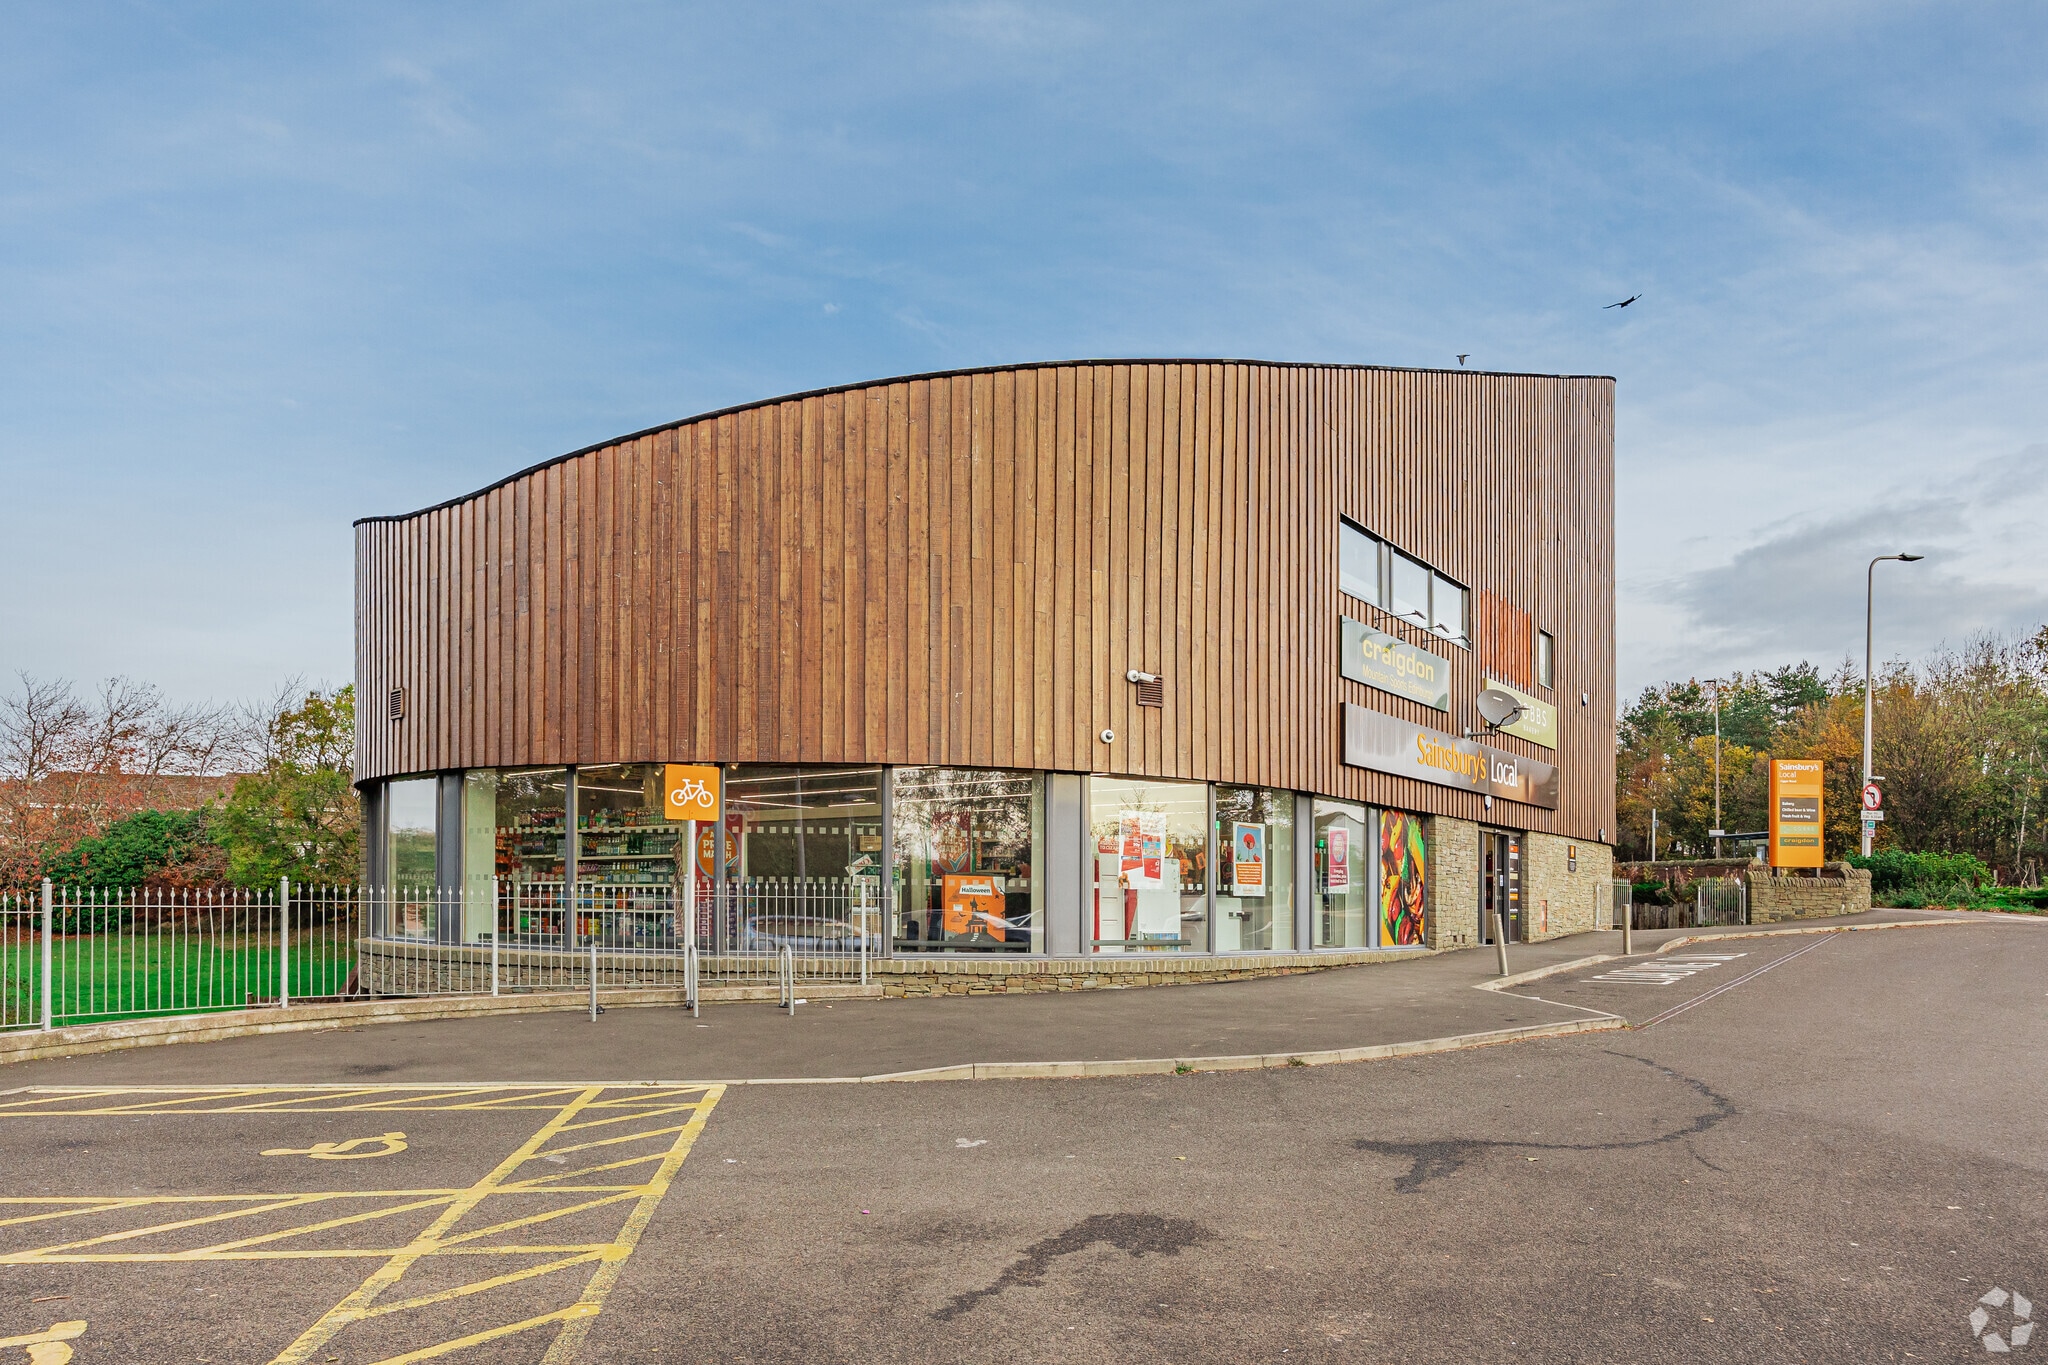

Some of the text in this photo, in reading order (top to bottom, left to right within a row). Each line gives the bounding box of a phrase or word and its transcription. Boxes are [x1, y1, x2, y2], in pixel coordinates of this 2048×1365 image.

[1362, 639, 1434, 682] craigdon
[1362, 663, 1434, 702] Mountain Sports Edinburgh
[1518, 700, 1547, 727] OBBS
[1417, 733, 1518, 788] Sainsbury's Local
[1779, 763, 1819, 773] Sainsbury's
[703, 839, 732, 850] PRE
